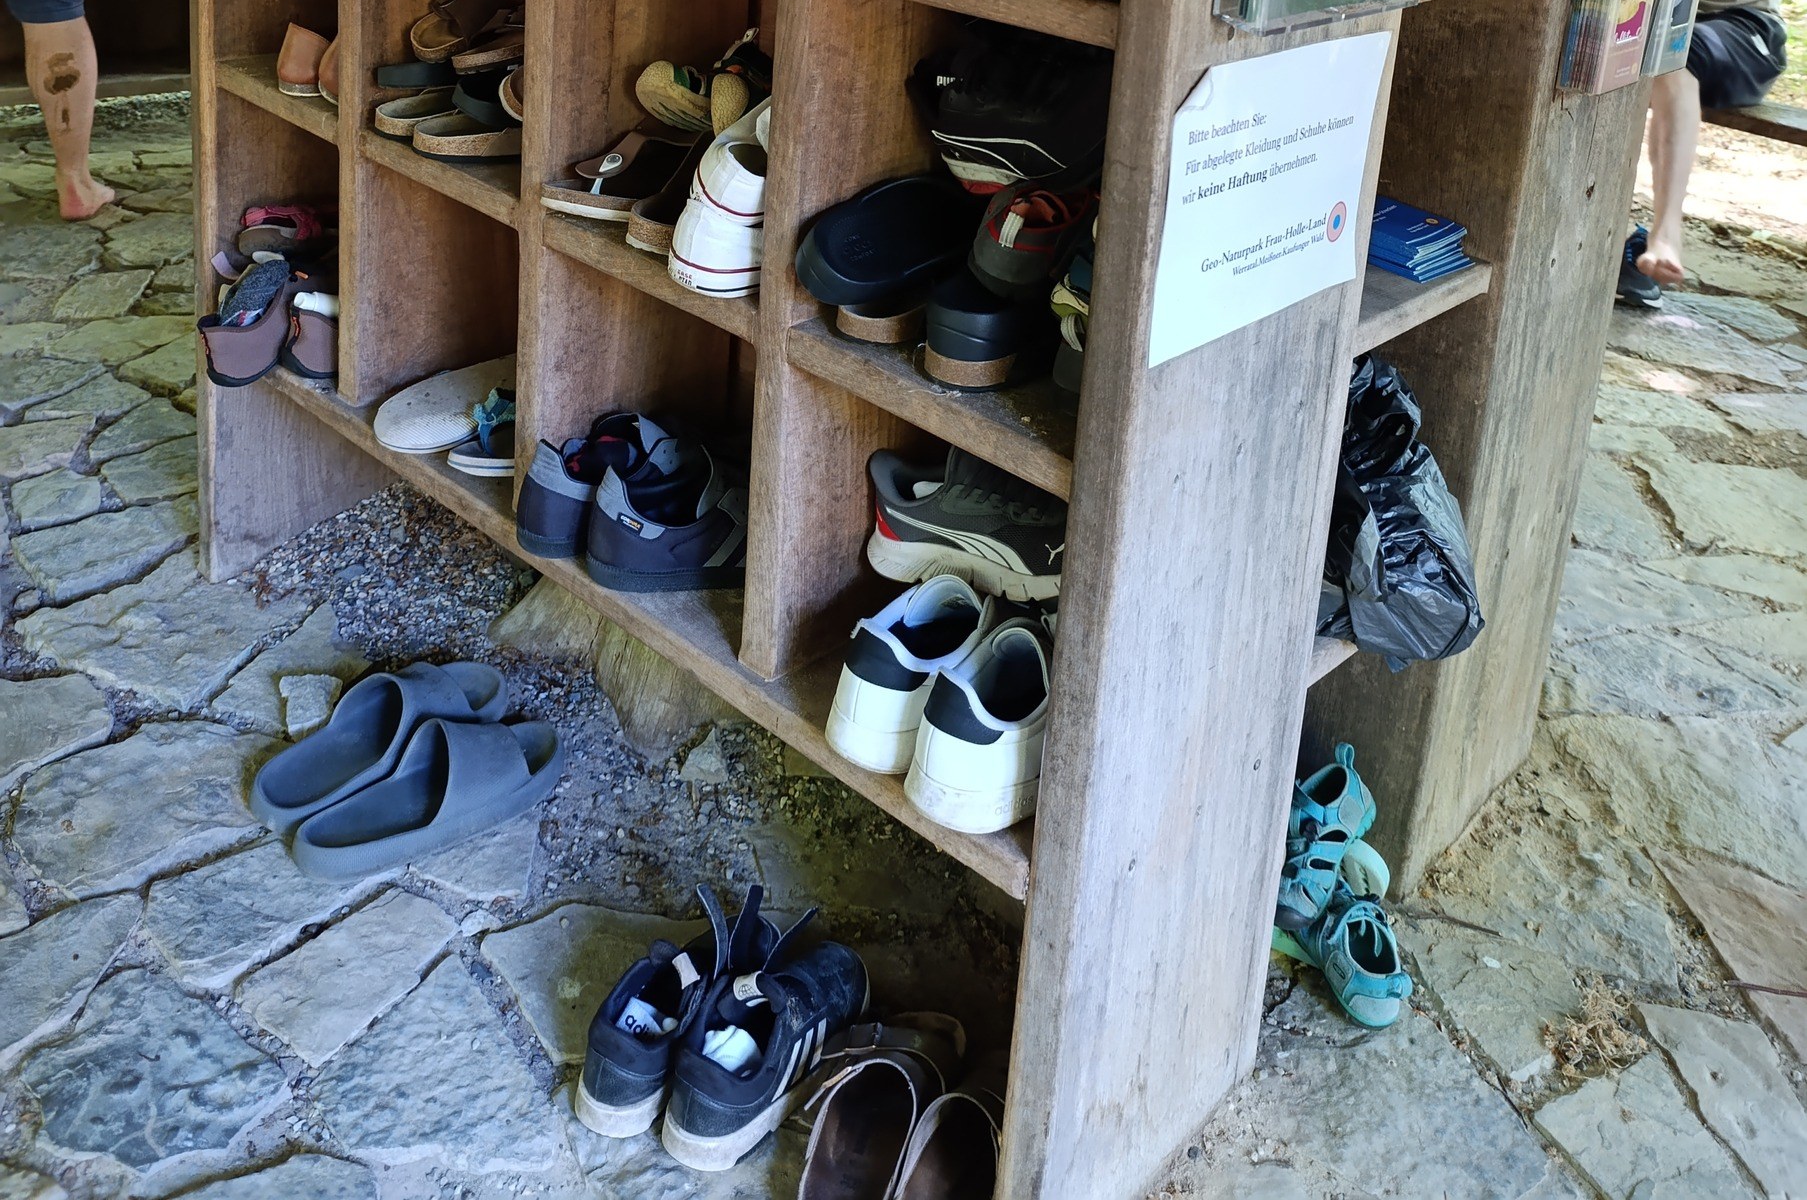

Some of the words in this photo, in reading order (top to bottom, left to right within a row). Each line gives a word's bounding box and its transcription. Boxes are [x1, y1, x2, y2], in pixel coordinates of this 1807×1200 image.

[1185, 158, 1201, 176] Für
[1202, 148, 1243, 170] abgelegte
[1245, 136, 1282, 157] Kleidung
[1283, 129, 1299, 145] und
[1299, 123, 1327, 141] Schuhe
[1327, 115, 1355, 132] können
[1188, 129, 1210, 145] Bitte
[1211, 118, 1250, 139] beachten
[1251, 112, 1267, 128] Sie:
[1182, 189, 1197, 206] wir
[1197, 181, 1226, 200] keine
[1228, 168, 1268, 191] Haftung
[1269, 152, 1318, 177] übernehmen.
[1201, 238, 1263, 273] Geo-Naturpark
[1265, 212, 1327, 249] Frau-Holle-Land
[1311, 231, 1326, 245] Wald
